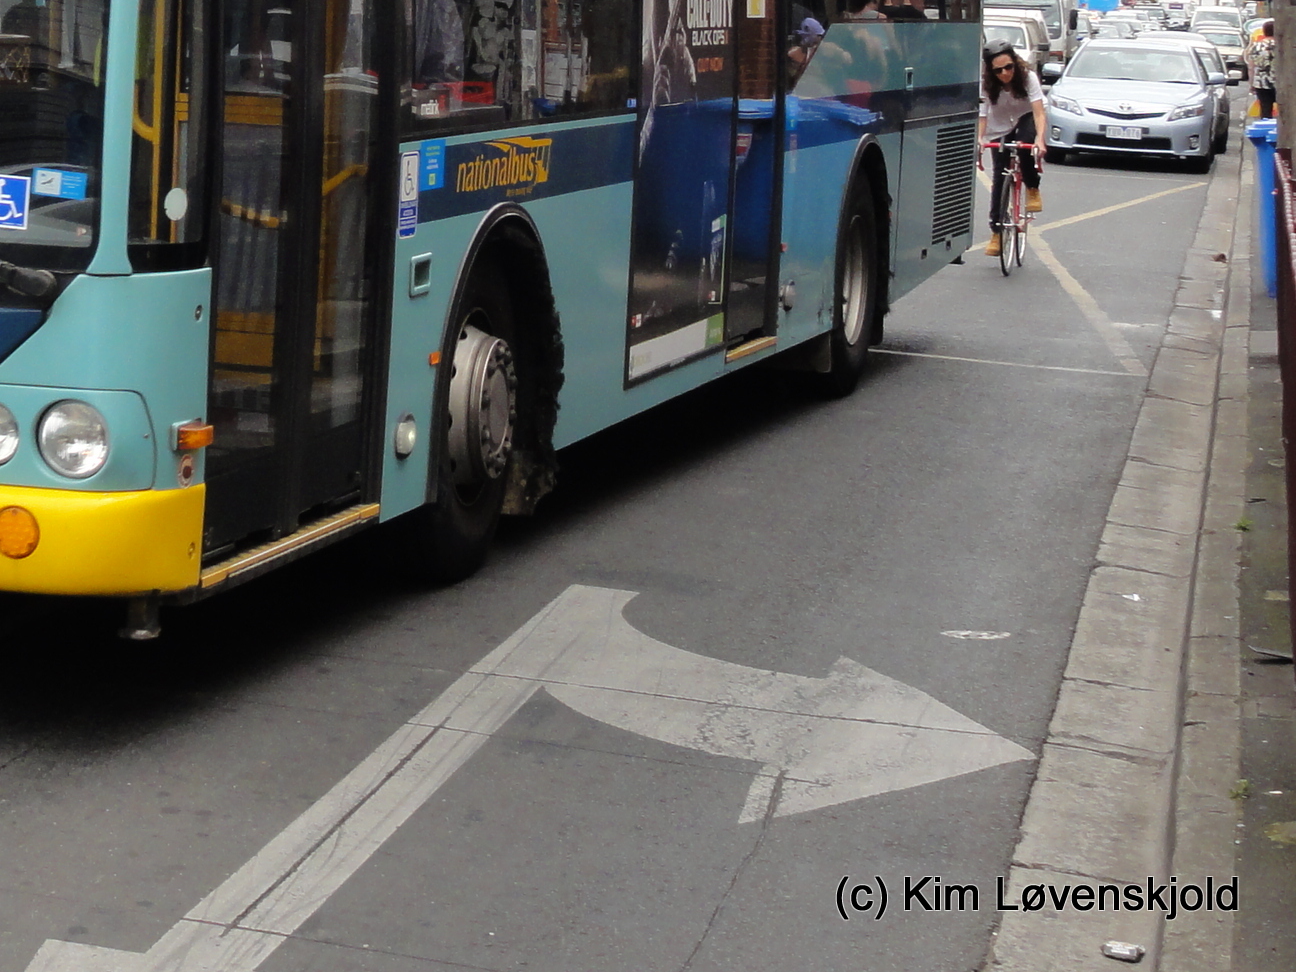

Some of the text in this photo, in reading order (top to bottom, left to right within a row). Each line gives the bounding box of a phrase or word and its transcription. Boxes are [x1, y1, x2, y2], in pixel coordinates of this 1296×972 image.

[692, 31, 713, 46] BLACK
[713, 30, 724, 45] OPS
[456, 146, 536, 193] nationalbus
